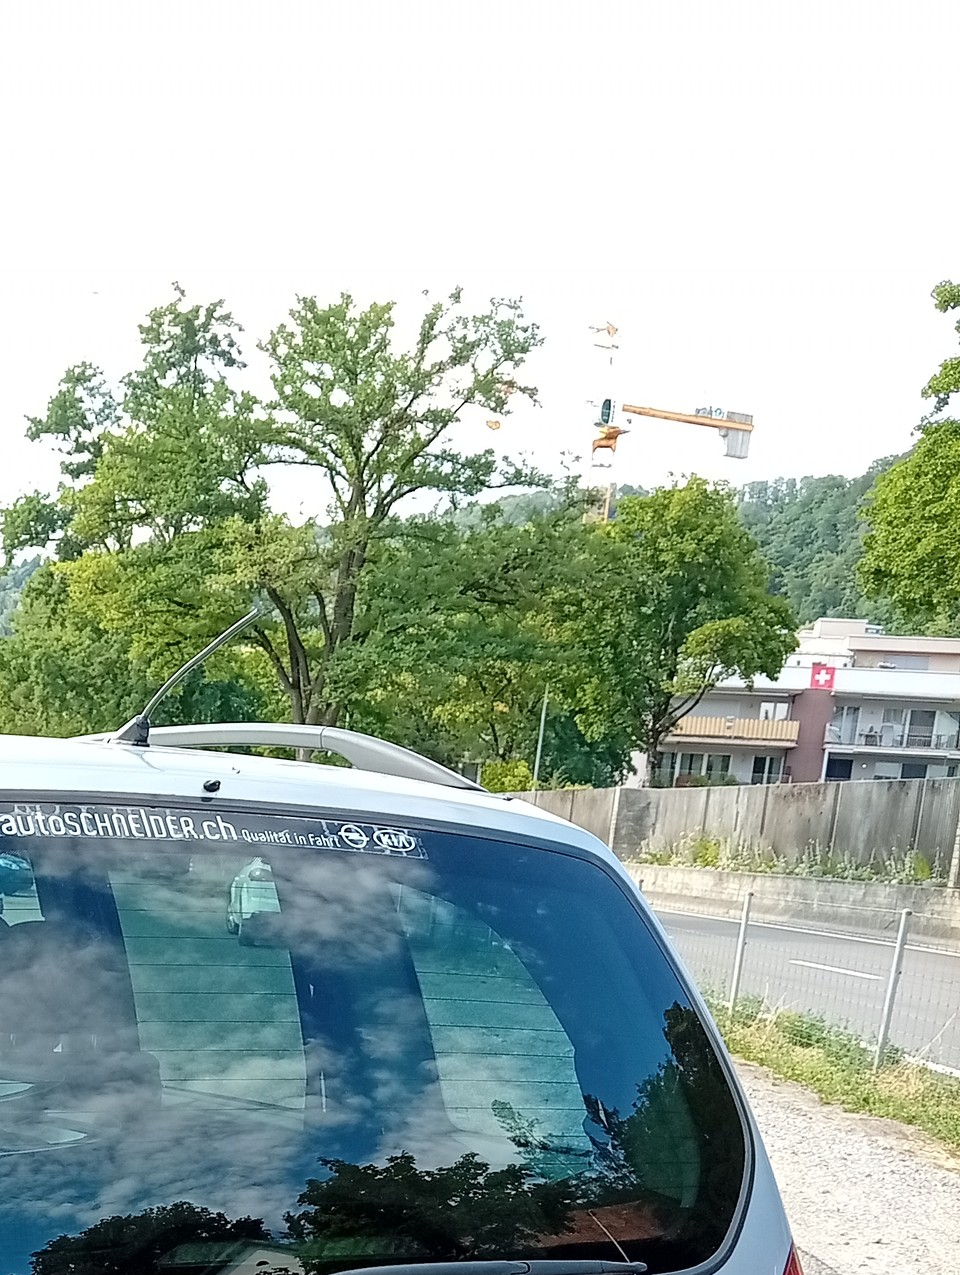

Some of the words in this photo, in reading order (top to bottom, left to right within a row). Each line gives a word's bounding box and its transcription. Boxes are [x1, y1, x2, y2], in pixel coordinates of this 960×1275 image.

[0, 809, 238, 841] autoSCHNEIDER.ch
[241, 829, 292, 844] Qualität
[294, 833, 307, 845] in
[309, 833, 341, 848] Fahrt
[379, 833, 411, 848] KIA
